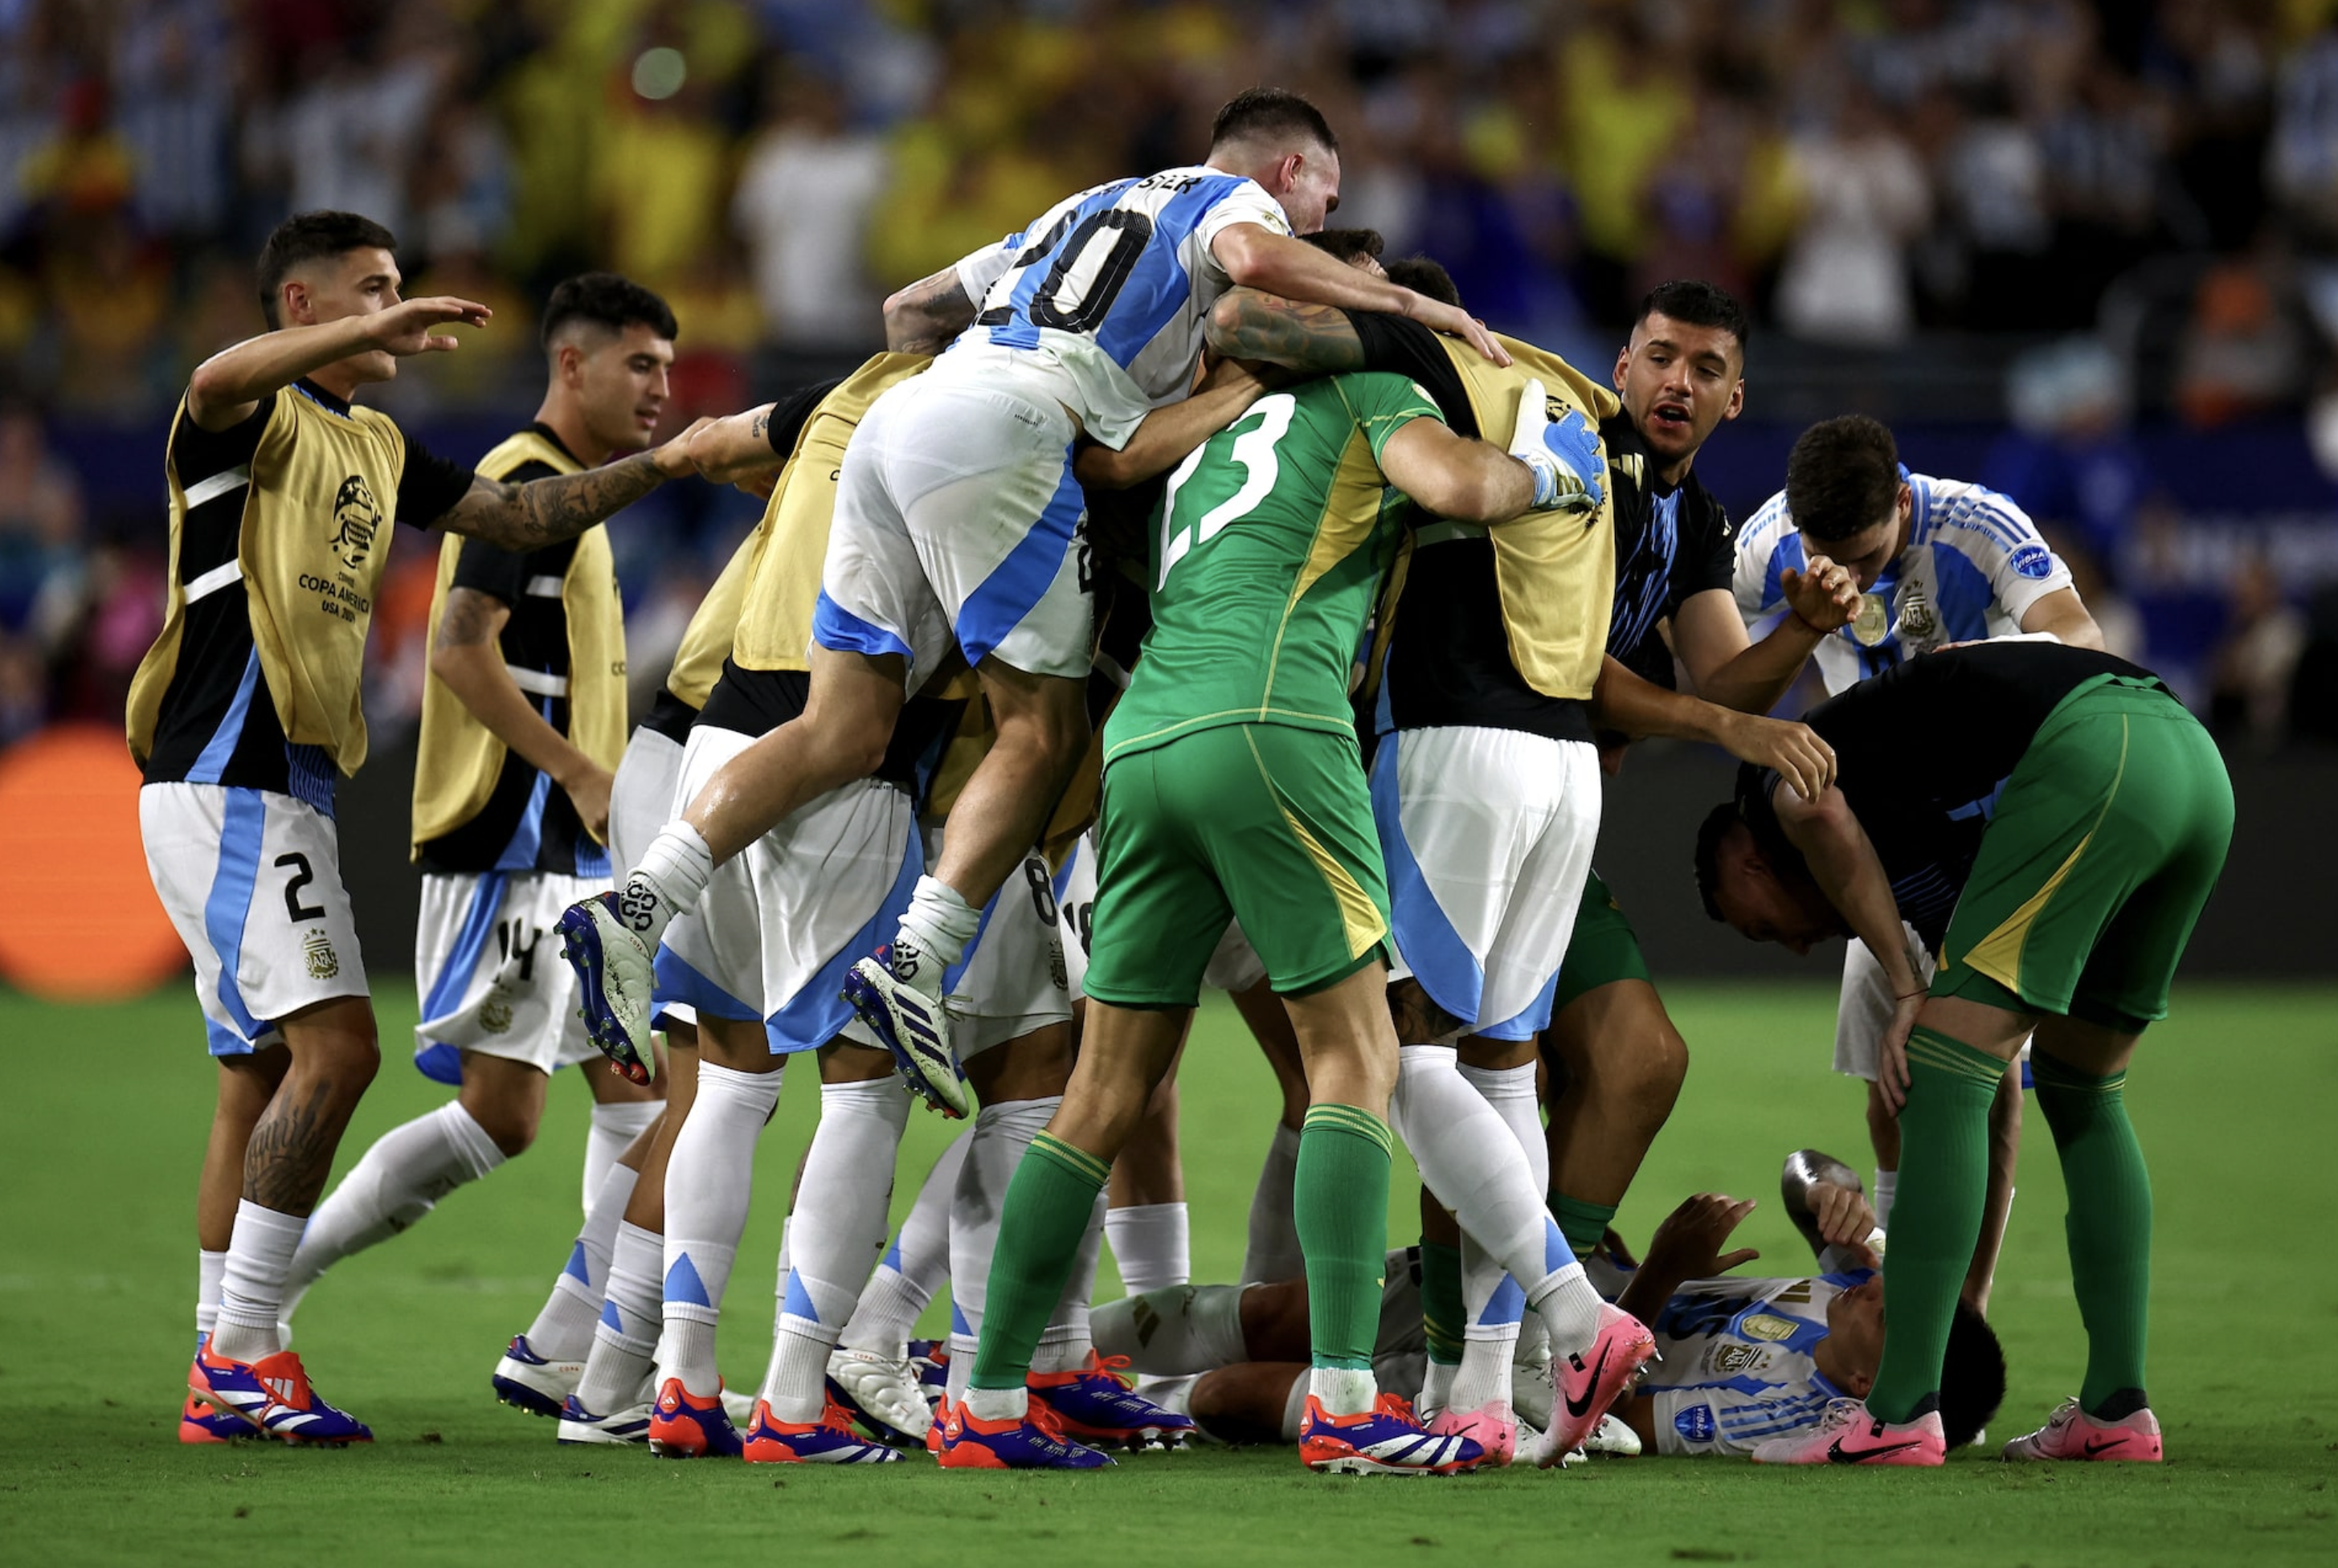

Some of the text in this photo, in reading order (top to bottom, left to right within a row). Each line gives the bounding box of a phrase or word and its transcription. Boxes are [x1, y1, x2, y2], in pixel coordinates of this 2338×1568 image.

[975, 208, 1154, 333] 20
[298, 574, 337, 598] COPA
[321, 599, 339, 617] USA
[273, 851, 326, 923] 2
[1024, 858, 1057, 927] 8
[313, 949, 333, 969] AFA
[497, 917, 544, 981] 14
[1695, 1407, 1706, 1439] VIBRA
